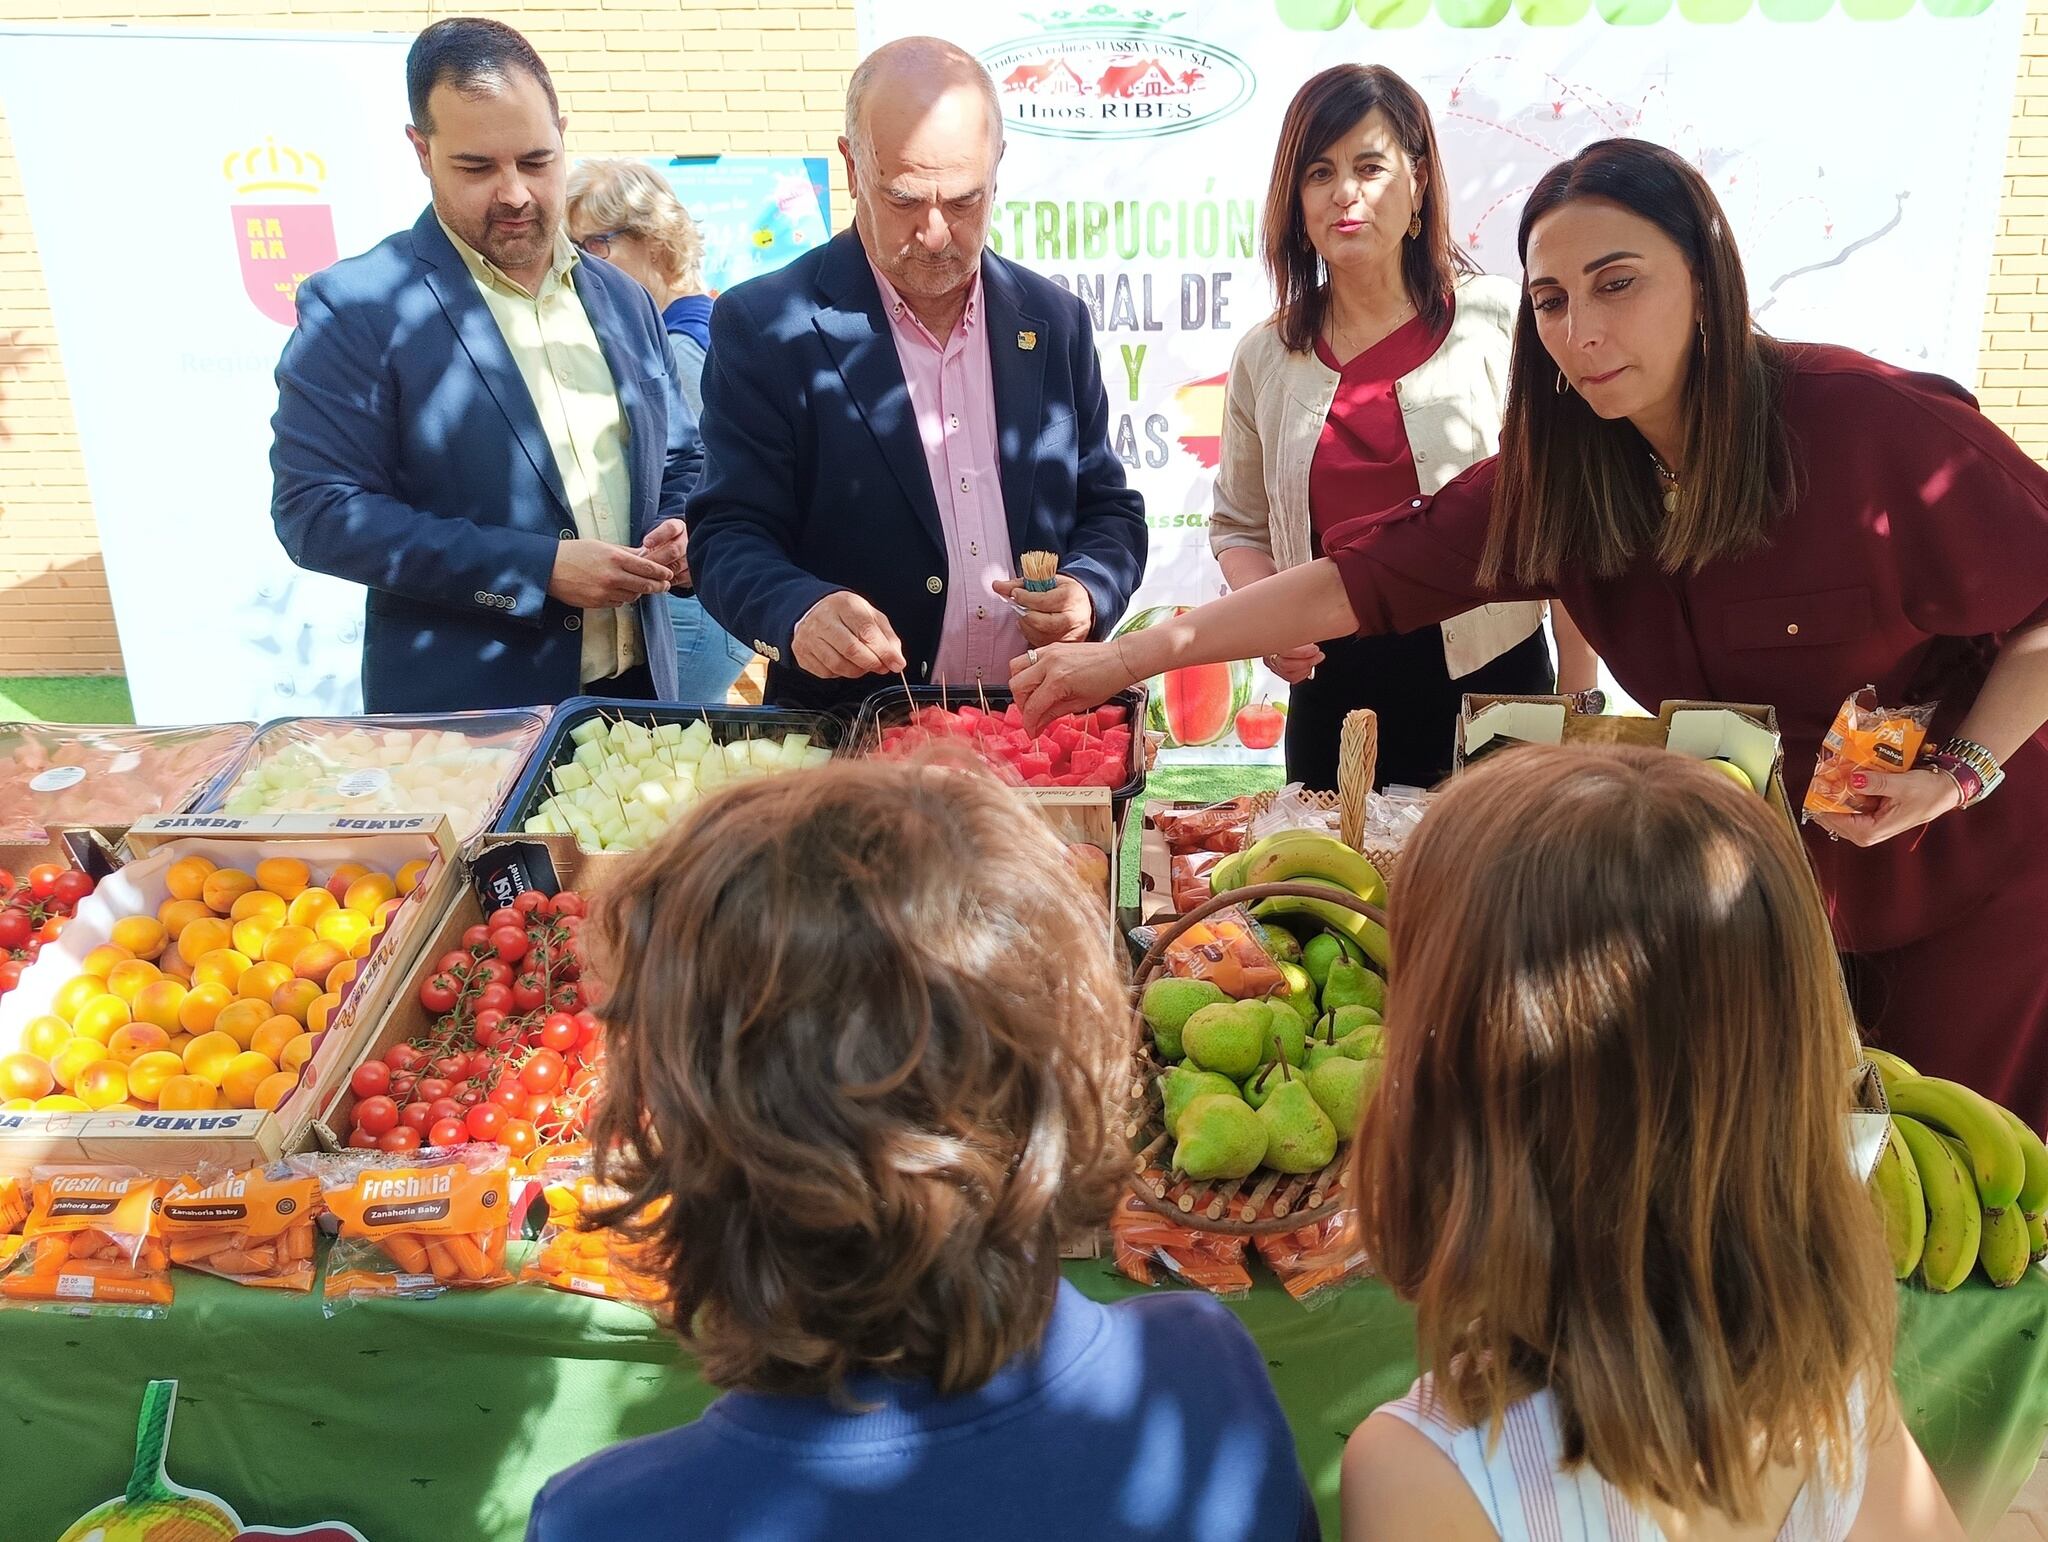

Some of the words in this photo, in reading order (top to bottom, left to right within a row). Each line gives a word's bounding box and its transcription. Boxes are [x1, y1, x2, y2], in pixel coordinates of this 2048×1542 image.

[1101, 102, 1193, 119] RIBES
[1180, 271, 1233, 331] DE
[1119, 343, 1148, 402] Y
[153, 817, 243, 830] SAMBA
[335, 817, 424, 830] SAMBA
[134, 1113, 243, 1131] SAMBA
[362, 1174, 451, 1201] Freshkia
[170, 1208, 214, 1217] Zanahoria
[215, 1208, 239, 1217] Baby
[371, 1207, 416, 1220] Zanahoria
[417, 1204, 442, 1216] Baby
